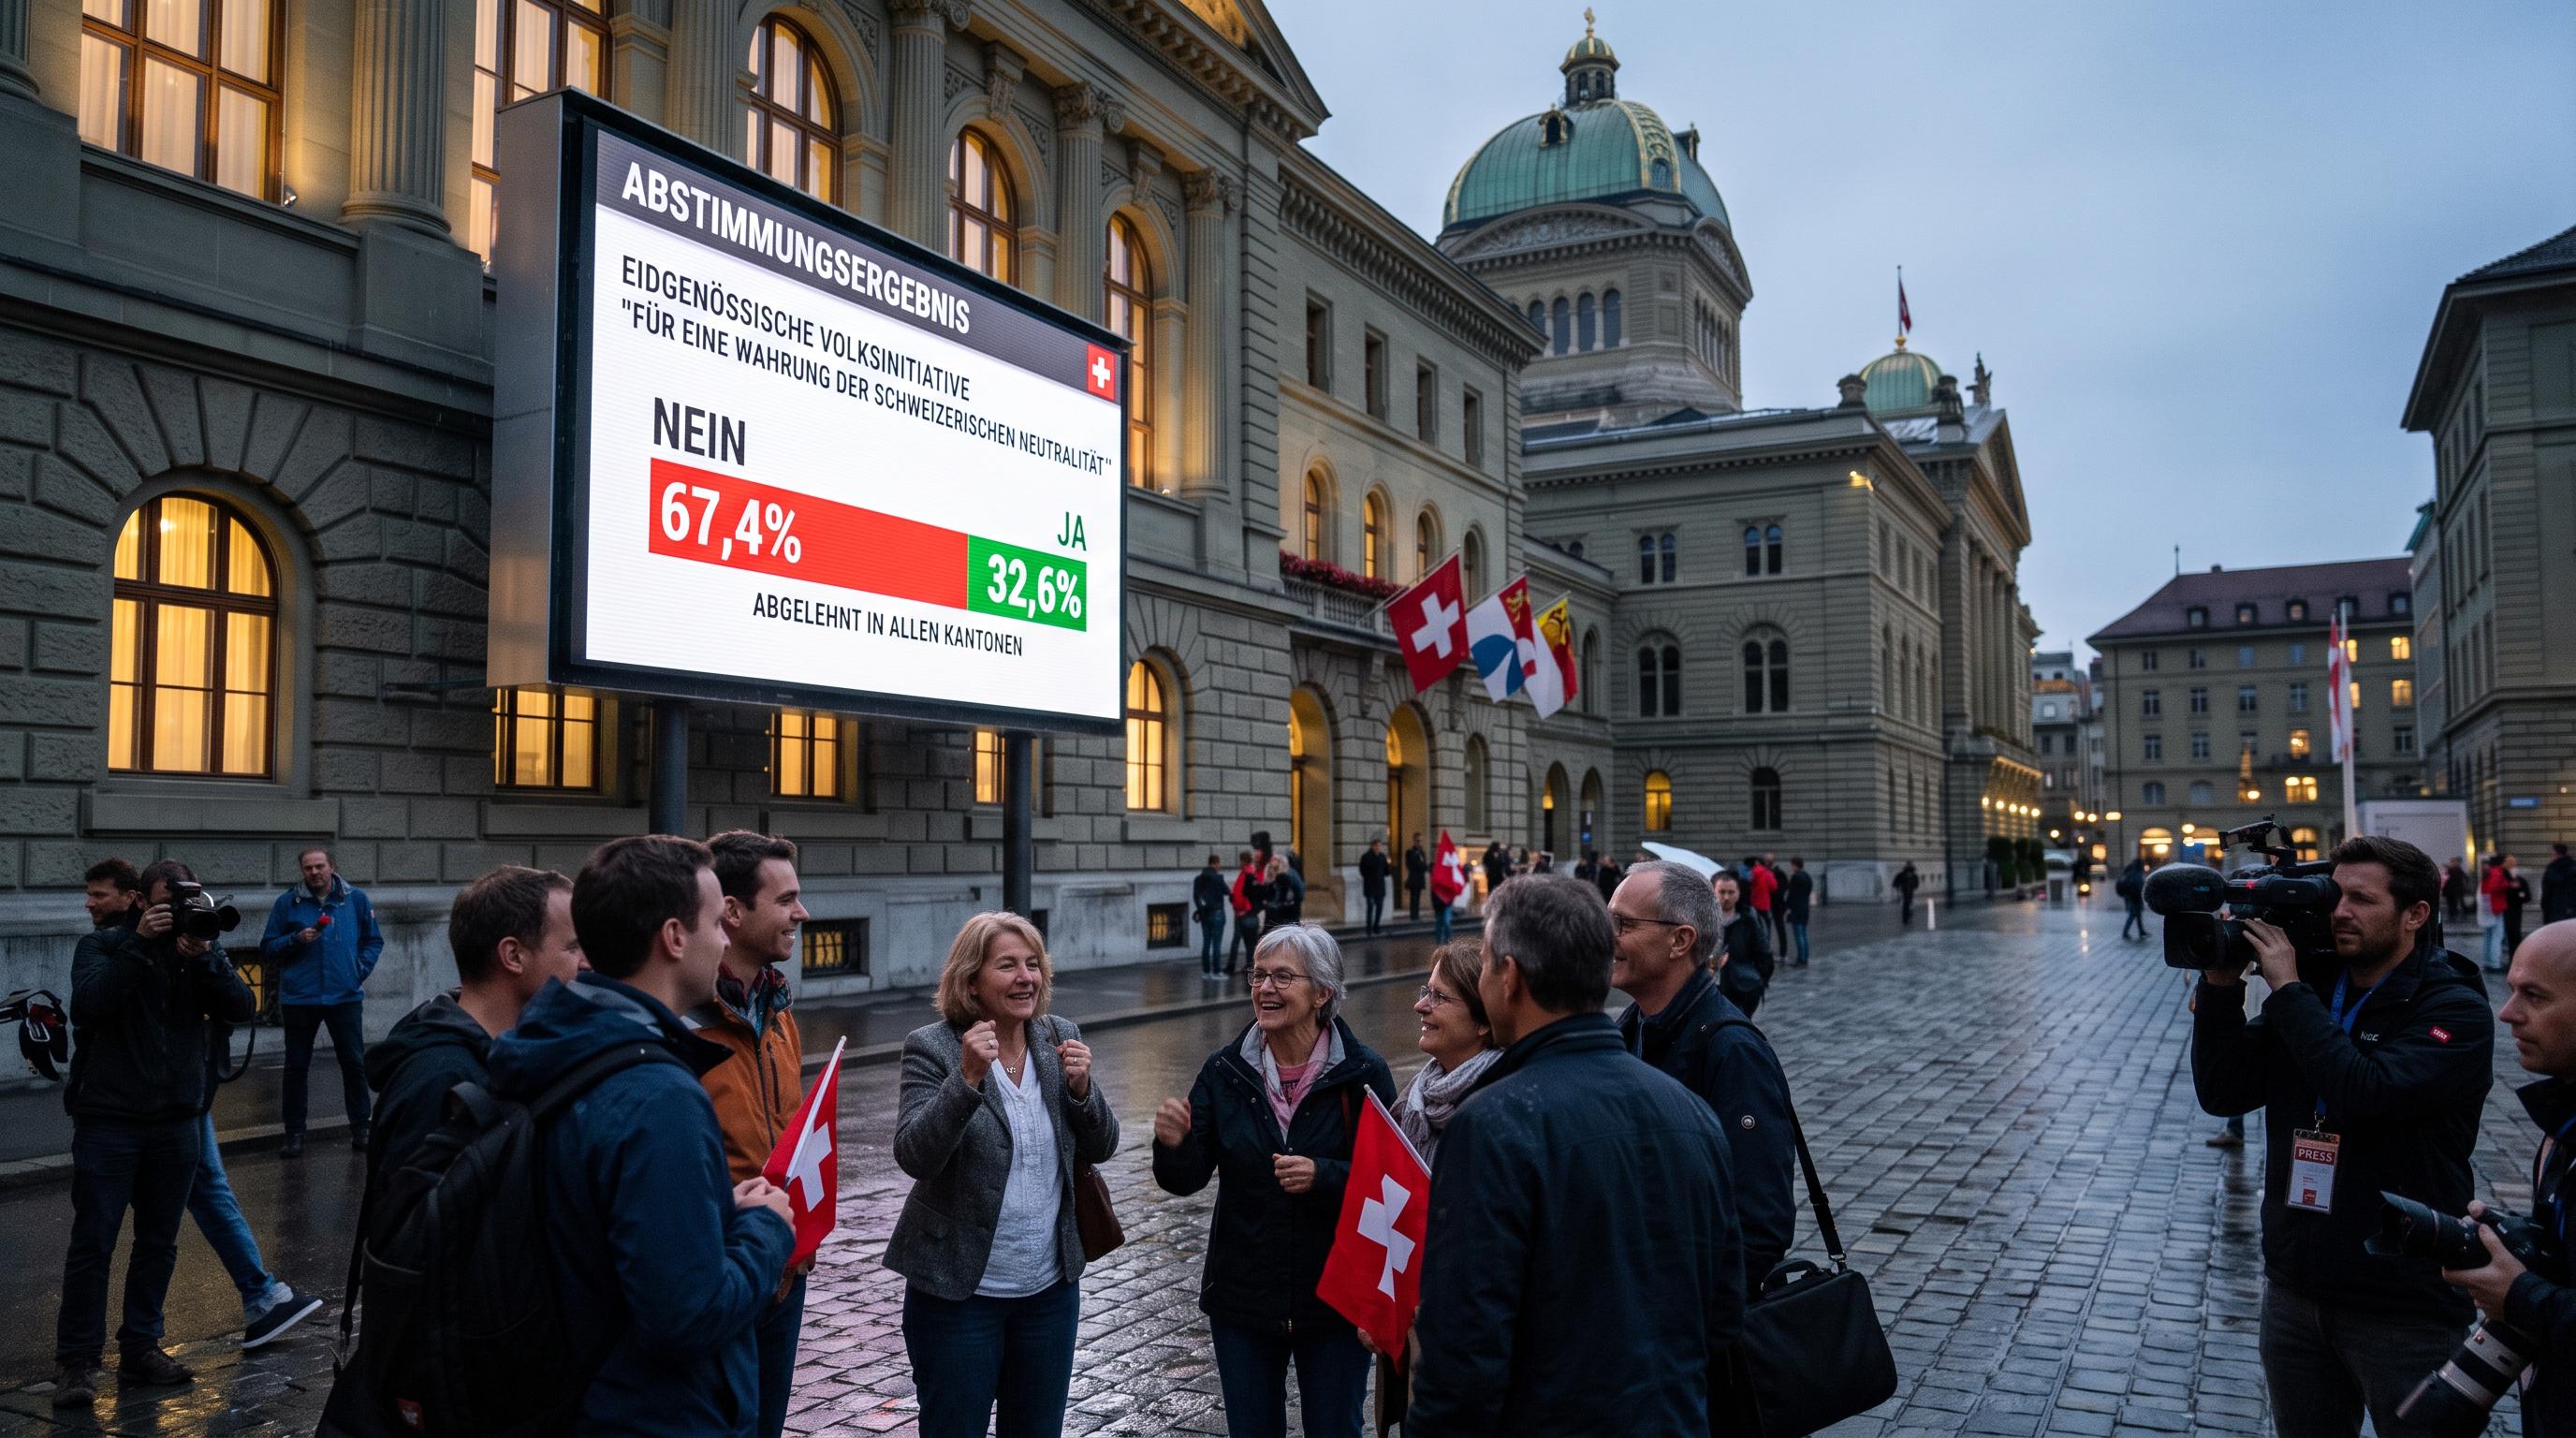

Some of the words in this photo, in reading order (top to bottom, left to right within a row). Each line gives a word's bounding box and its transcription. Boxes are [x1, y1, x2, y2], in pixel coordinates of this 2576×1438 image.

[622, 162, 971, 334] ABSTIMMUNGSERGEBNIS
[622, 256, 814, 348] EIDGENÖSSISCHE
[820, 326, 970, 401] VOLKSINITIATIVE
[622, 298, 675, 341] "FÜR
[682, 318, 729, 358] EINE
[735, 336, 830, 389] WAHRUNG
[836, 370, 869, 402] DER
[874, 383, 1016, 448] SCHWEIZERISCHEN
[1019, 431, 1113, 476] NEUTRALITÄT"
[653, 396, 746, 466] NEIN
[661, 481, 802, 564] 67,4%
[1057, 510, 1087, 551] JA
[988, 553, 1082, 619] 32,6%
[753, 592, 862, 632] ABGELEHNT
[867, 610, 884, 636] IN
[888, 615, 939, 643] ALLEN
[944, 624, 1022, 656] KANTONEN
[2298, 1149, 2333, 1162] PRESS
